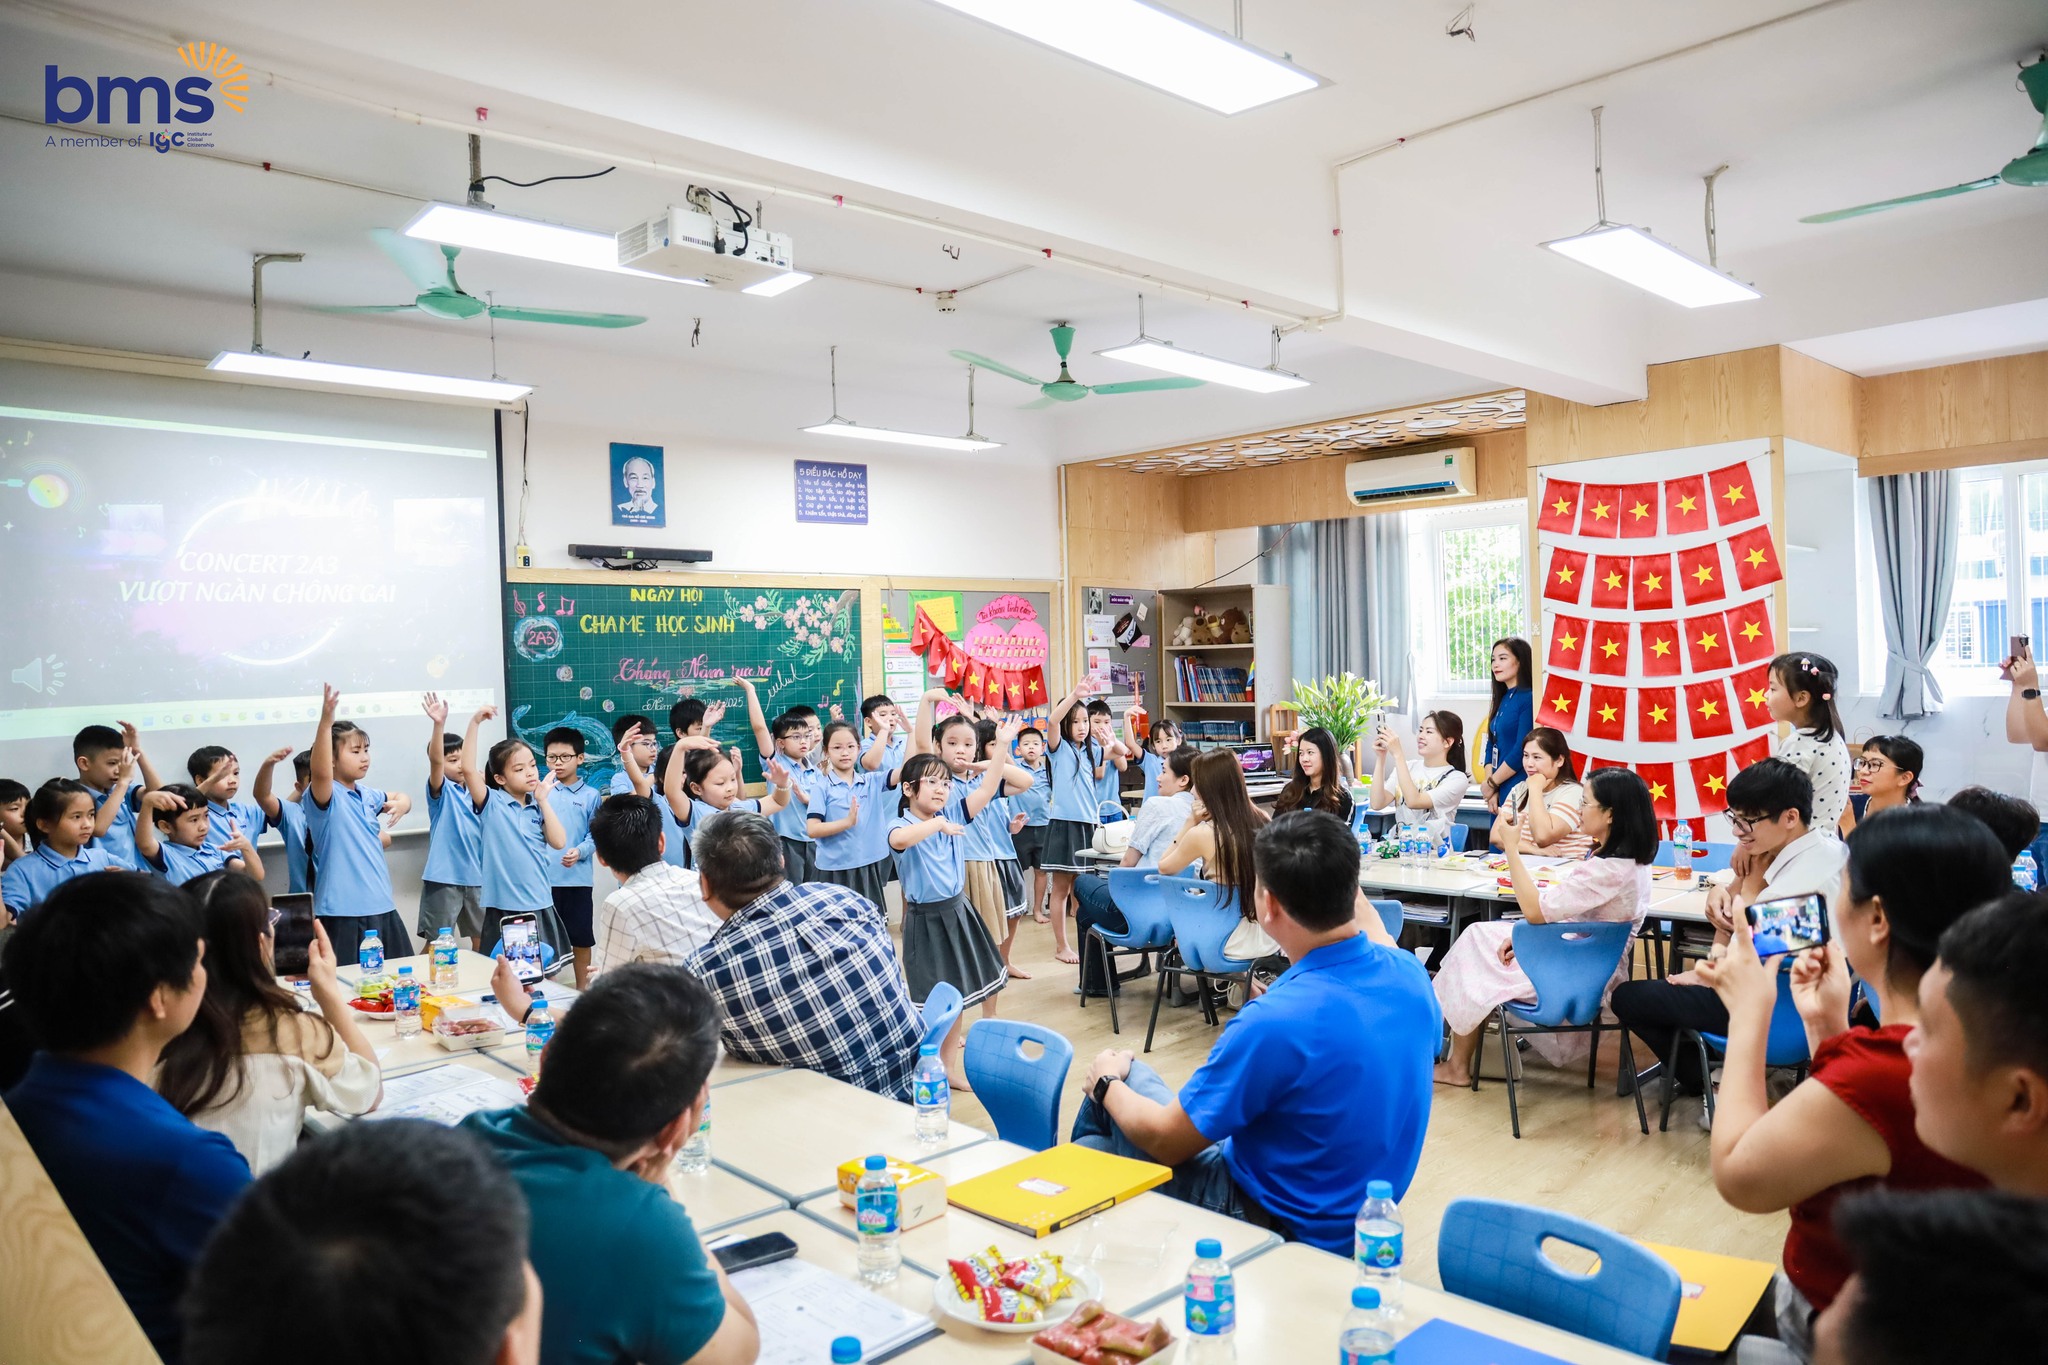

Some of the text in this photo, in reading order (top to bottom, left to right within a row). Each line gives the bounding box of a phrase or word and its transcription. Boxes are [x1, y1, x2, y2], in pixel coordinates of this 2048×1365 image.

[180, 551, 339, 575] CONCERT 2A3
[119, 579, 193, 605] VƯỢT
[195, 578, 265, 603] NGÀN
[360, 584, 397, 603] GAI
[580, 614, 735, 636] CHA MẸ HỌC SINH
[527, 630, 556, 645] 2A3
